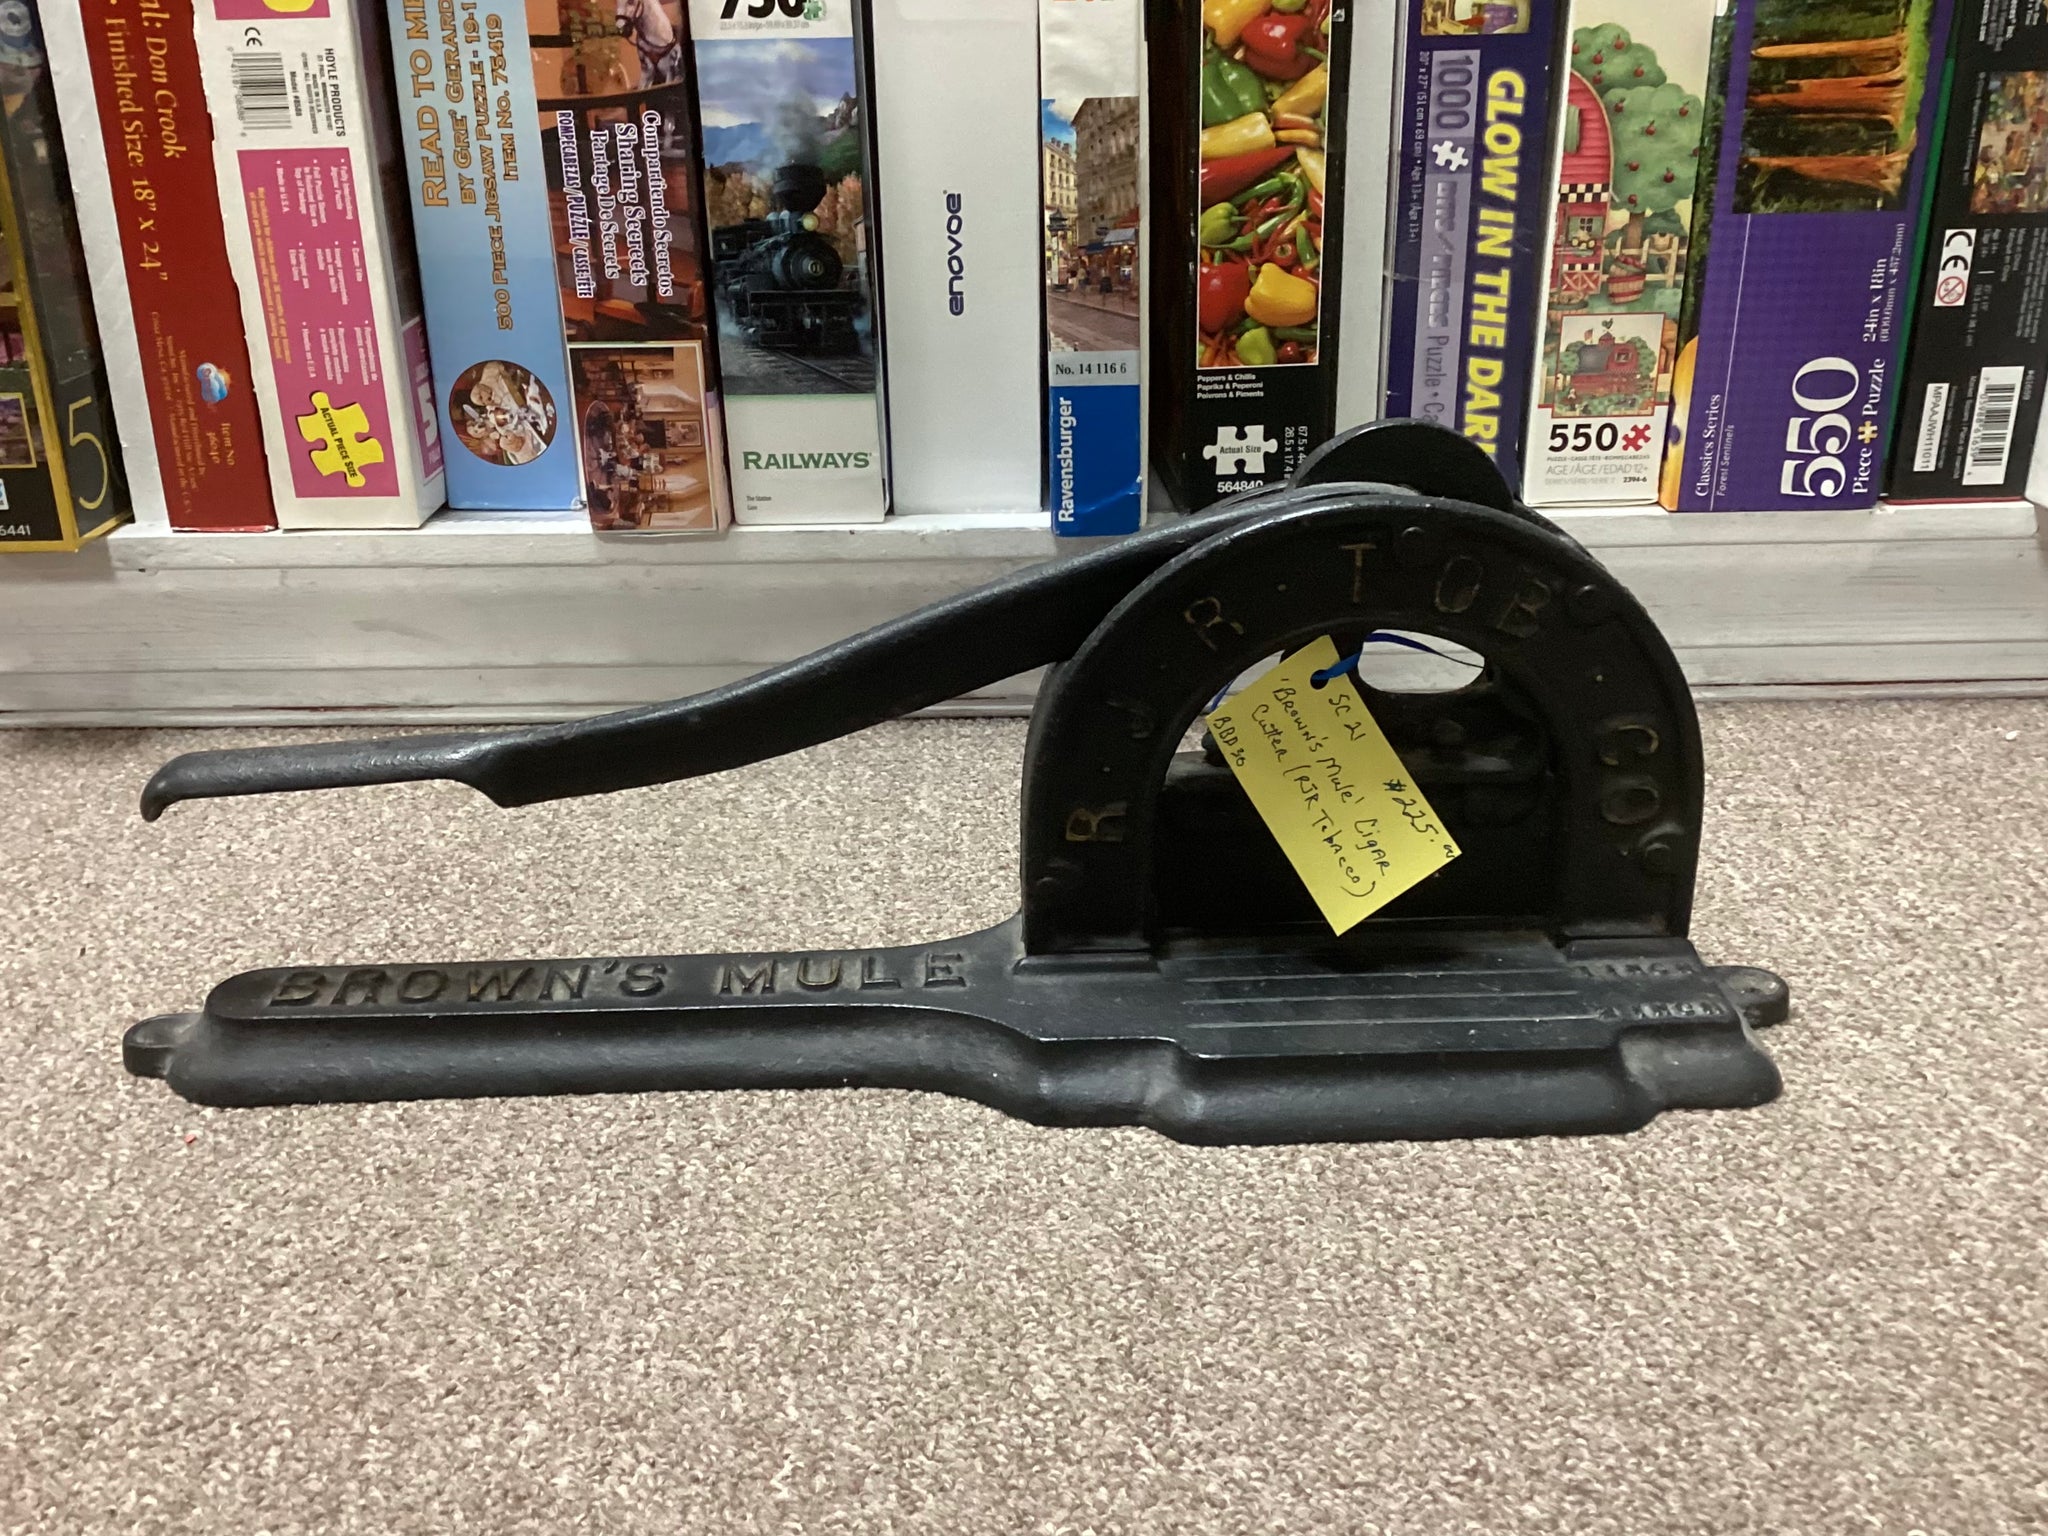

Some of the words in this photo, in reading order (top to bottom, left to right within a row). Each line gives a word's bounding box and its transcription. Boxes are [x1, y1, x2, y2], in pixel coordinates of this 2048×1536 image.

[146, 37, 168, 83] Don
[324, 48, 338, 80] HOYLE
[409, 49, 435, 98] TO
[486, 13, 508, 86] 75419
[290, 71, 299, 93] Model
[470, 61, 492, 141] PUZZLE
[1435, 55, 1474, 130] 1000
[105, 18, 144, 114] Finished
[138, 217, 156, 231] x
[155, 89, 188, 158] Crook
[329, 84, 346, 137] PRODUCTS
[496, 90, 513, 129] NO.
[1481, 69, 1525, 201] GLOW
[416, 105, 449, 207] READ
[502, 133, 519, 181] ITEM
[590, 130, 610, 195] Partage
[615, 123, 641, 204] Sharing
[641, 110, 669, 229] Compartiendo
[459, 173, 476, 205] BY
[480, 145, 501, 222] JIGSAW
[598, 195, 616, 220] De
[489, 226, 509, 284] PIECE
[600, 221, 620, 279] Secrets
[1476, 208, 1515, 258] IN
[654, 229, 674, 297] Secretos
[1869, 259, 1887, 290] 18in
[494, 289, 513, 330] 500
[1469, 268, 1510, 347] THE
[1862, 308, 1880, 342] 24in
[1871, 295, 1882, 304] x
[1055, 363, 1075, 375] No.
[1079, 363, 1092, 374] 14
[1097, 363, 1117, 374] 116
[1120, 363, 1127, 374] 6
[1232, 382, 1263, 390] Peperoni
[1424, 335, 1450, 387] Puzzle
[1862, 358, 1886, 417] Puzzle
[1548, 423, 1618, 452] 550
[1702, 394, 1721, 438] Series
[1780, 356, 1860, 497] 550
[321, 407, 339, 437] ACTUAL
[334, 437, 350, 460] PIECE
[345, 461, 358, 478] SIZE
[743, 451, 870, 470] RAILWAYS
[1057, 397, 1077, 522] Ravensburger
[1220, 446, 1243, 454] Actual
[1245, 445, 1261, 453] Size
[1721, 424, 1735, 467] Sentinels
[1695, 441, 1714, 497] Classics
[1716, 468, 1729, 497] Forest
[1852, 448, 1873, 494] Piece
[269, 958, 668, 1006] BROWN'S
[719, 952, 967, 995] MULE
